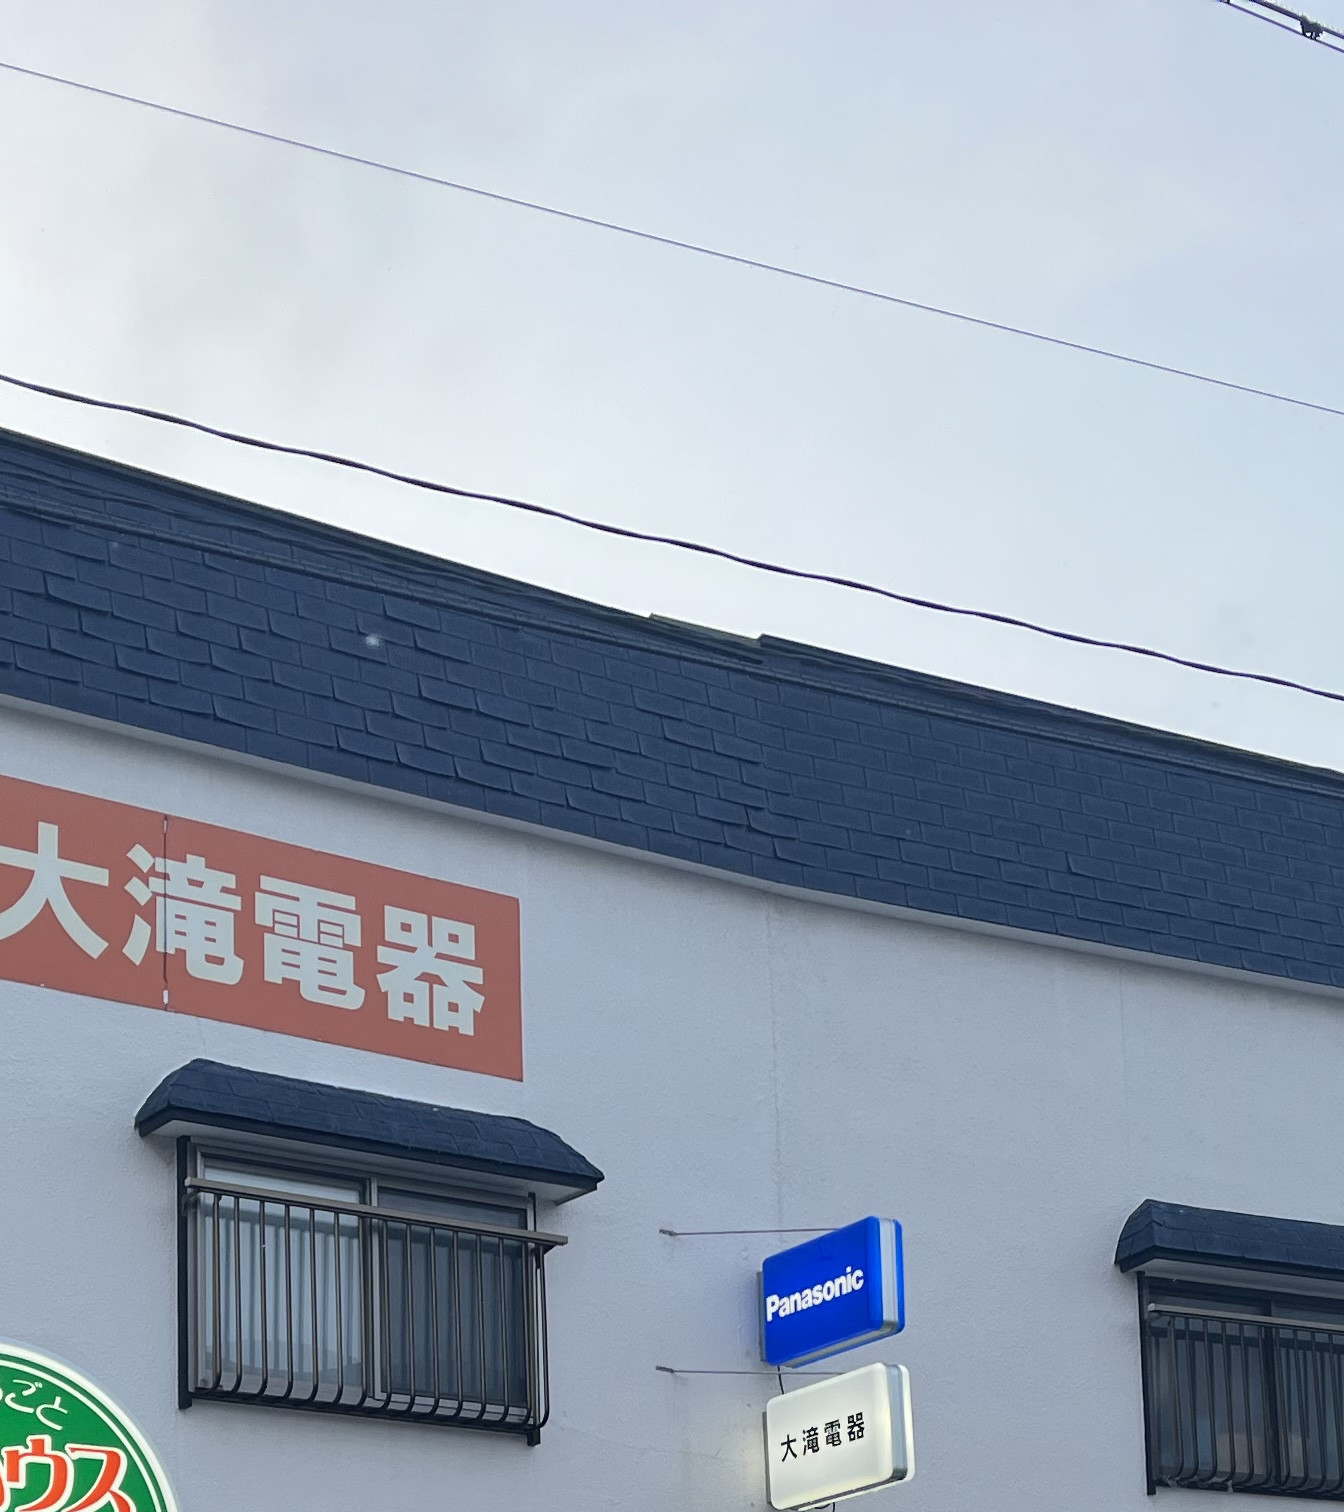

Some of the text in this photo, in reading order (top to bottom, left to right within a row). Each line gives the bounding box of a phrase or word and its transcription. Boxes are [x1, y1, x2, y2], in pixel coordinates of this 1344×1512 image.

[766, 1266, 864, 1322] Panasonic
[781, 1412, 865, 1462] 大滝電器
